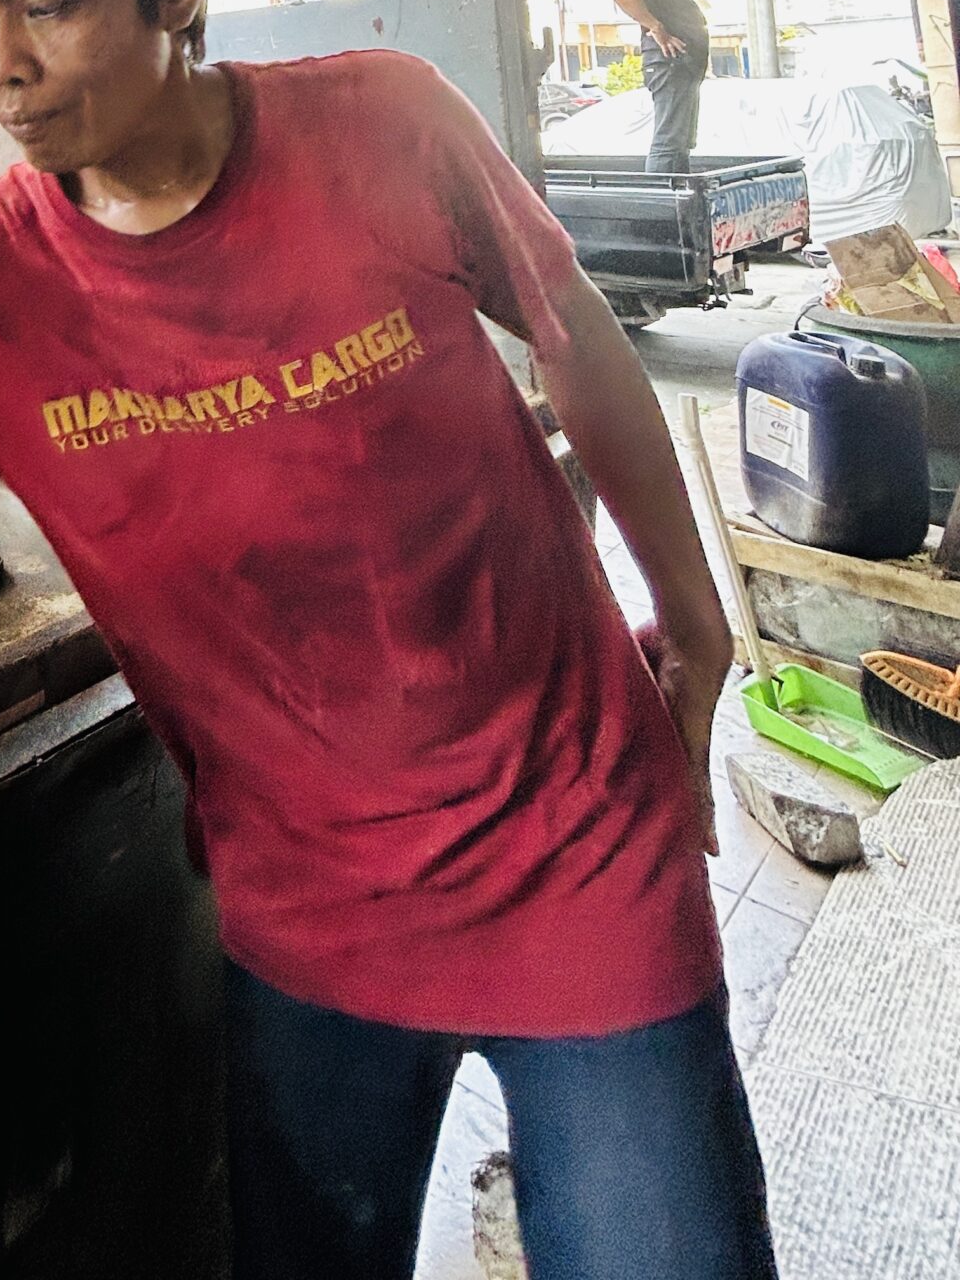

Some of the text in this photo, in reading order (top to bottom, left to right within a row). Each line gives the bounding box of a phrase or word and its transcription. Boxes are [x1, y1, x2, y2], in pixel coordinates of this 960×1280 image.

[55, 423, 129, 453] YOUR
[284, 340, 425, 413] SOLUTION
[279, 307, 416, 399] CARGO
